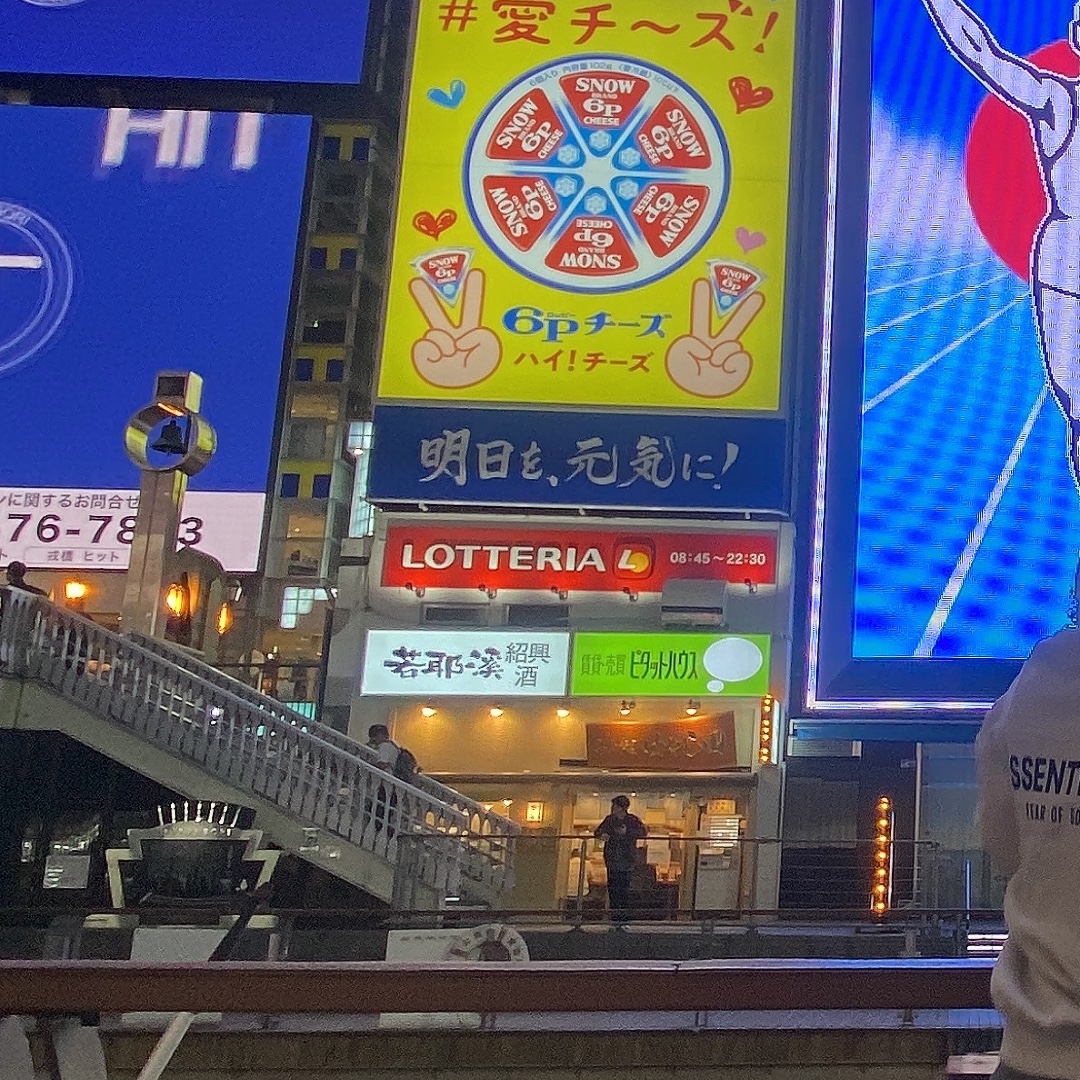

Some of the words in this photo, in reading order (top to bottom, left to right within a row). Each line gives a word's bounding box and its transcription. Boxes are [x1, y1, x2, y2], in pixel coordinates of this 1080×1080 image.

[575, 77, 636, 94] SNOW
[496, 97, 539, 150] SNOW
[665, 108, 706, 157] SNOW
[488, 187, 529, 237] SNOW
[659, 195, 700, 248] SNOW
[559, 252, 621, 269] SNOW
[402, 543, 607, 573] LOTTERIA
[630, 649, 699, 680] ピタットハウス
